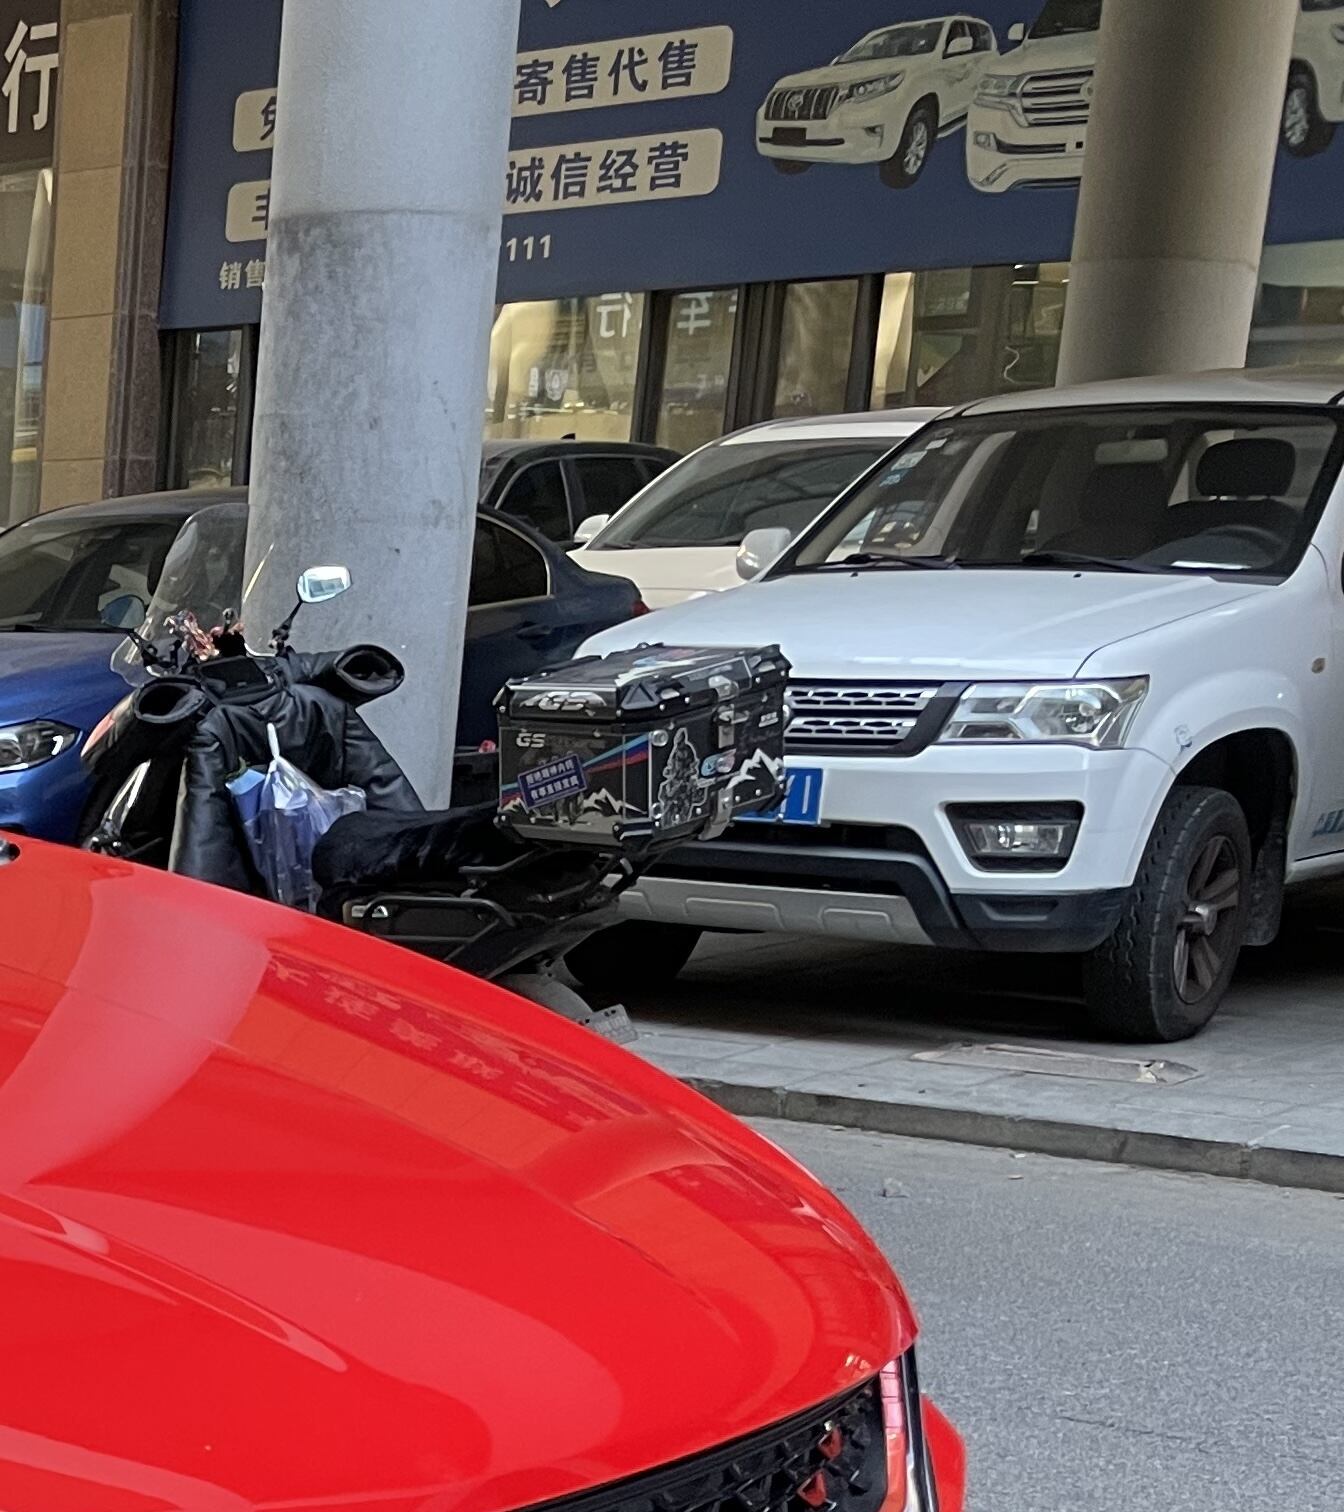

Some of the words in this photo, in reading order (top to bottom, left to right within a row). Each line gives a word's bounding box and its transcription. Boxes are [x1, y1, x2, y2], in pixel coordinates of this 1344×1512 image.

[514, 38, 698, 105] 寄售代售
[506, 140, 688, 203] 诚信经营
[516, 732, 547, 749] GS
